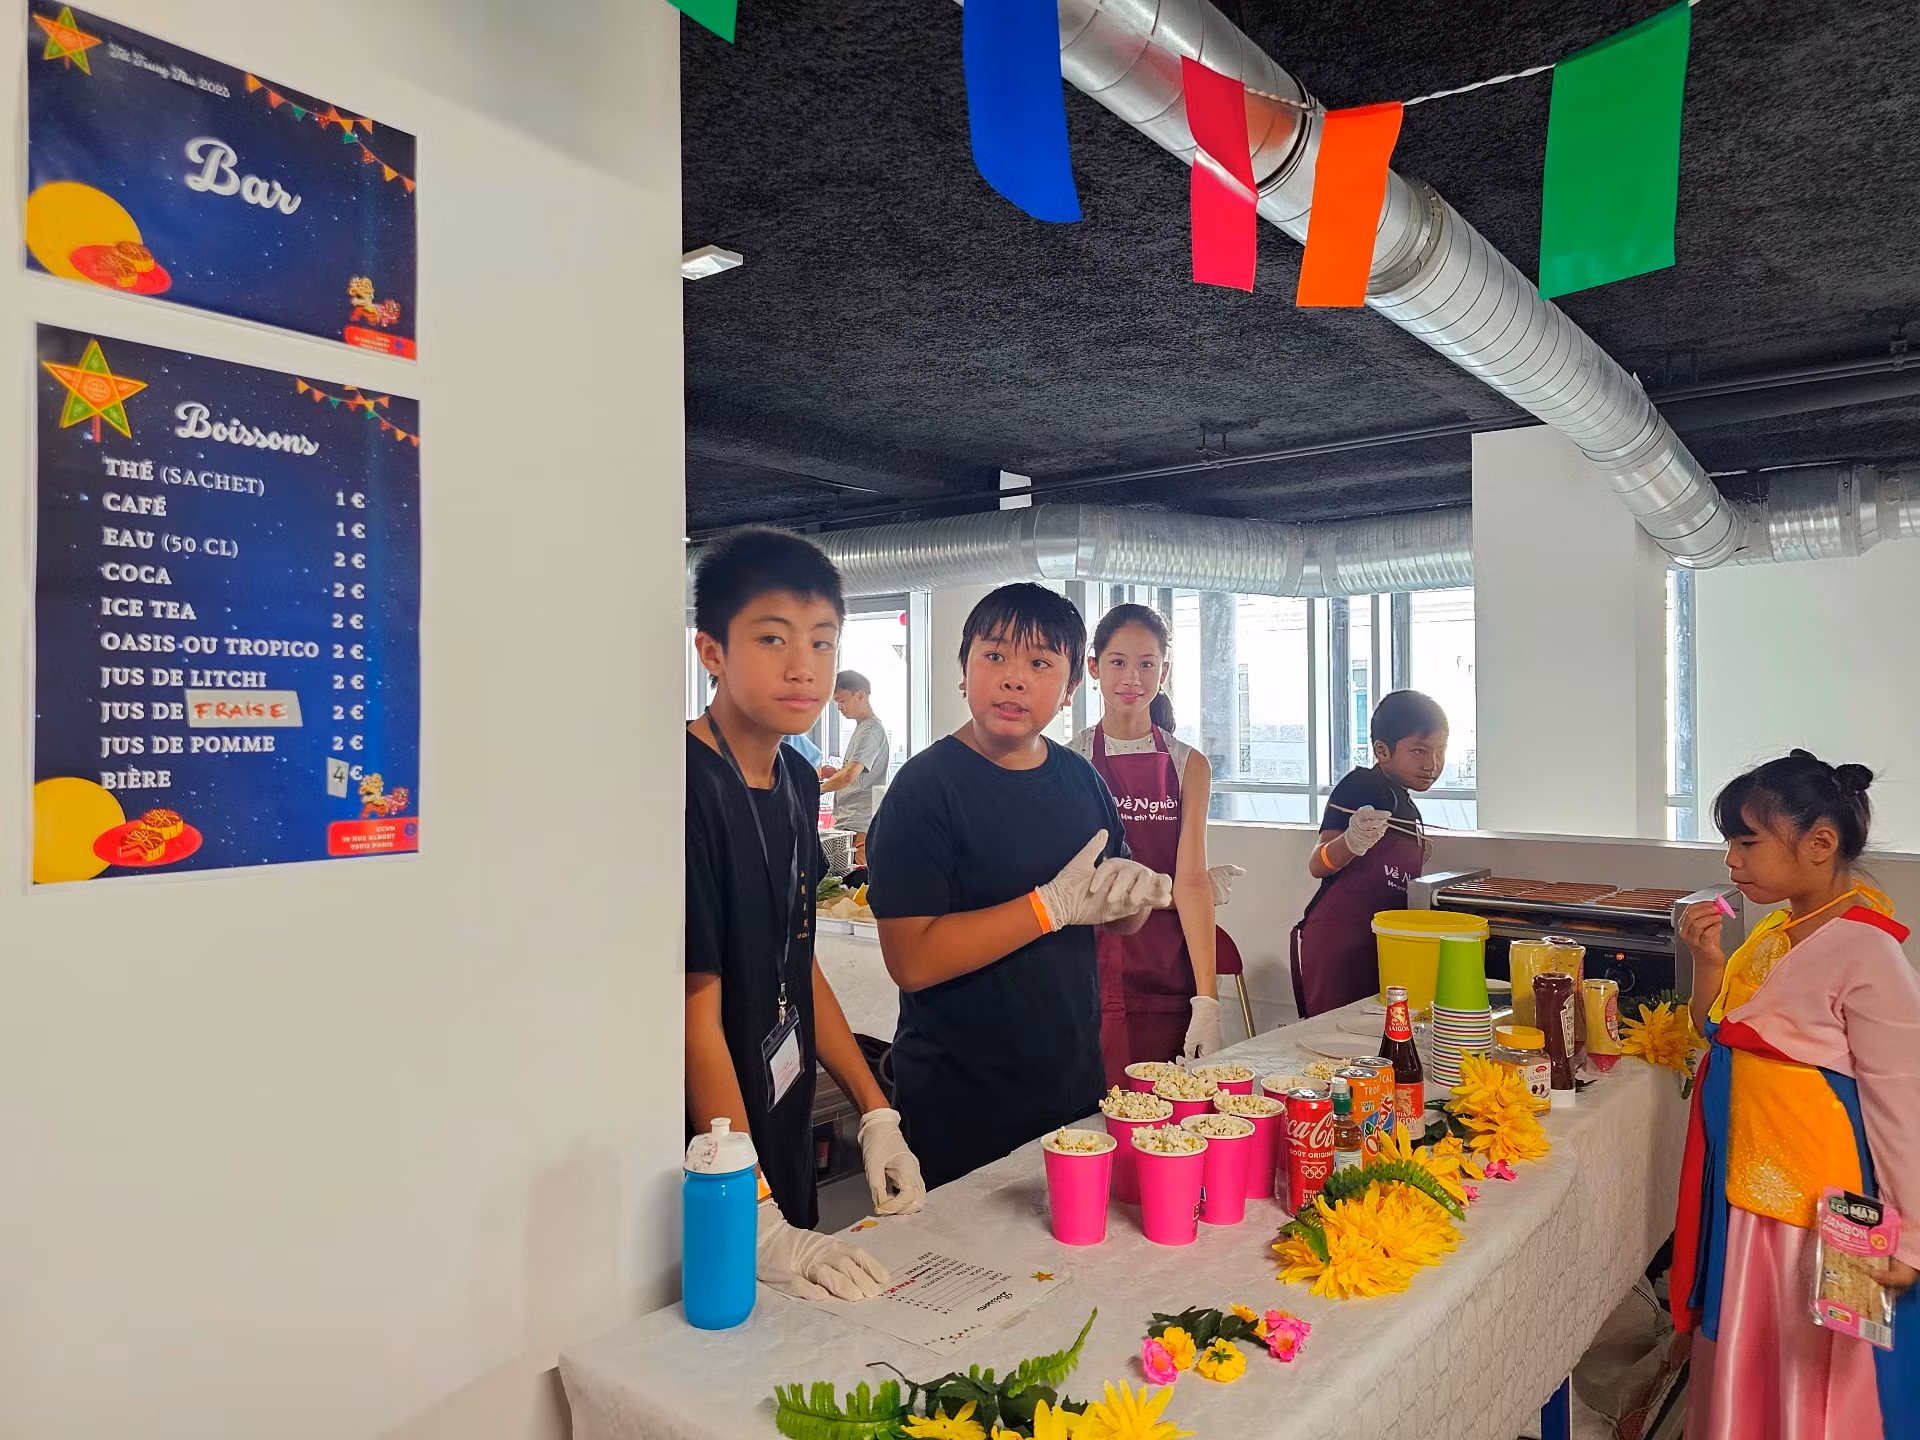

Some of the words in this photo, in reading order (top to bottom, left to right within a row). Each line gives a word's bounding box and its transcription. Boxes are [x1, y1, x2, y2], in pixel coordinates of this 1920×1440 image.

[199, 77, 231, 98] 2023
[184, 136, 302, 215] Bar
[174, 400, 320, 457] Boissons
[102, 455, 154, 482] THÉ
[160, 465, 265, 497] (SACHET)
[102, 492, 167, 517] CAFÉ
[335, 491, 345, 508] 1
[351, 493, 366, 510] €
[335, 521, 345, 538] 1
[351, 523, 366, 540] €
[102, 526, 154, 550] EAU
[161, 533, 196, 554] (50
[203, 537, 239, 559] CL)
[333, 551, 346, 568] 2
[351, 553, 366, 570] €
[102, 562, 172, 586] COCA
[333, 582, 346, 598] 2
[351, 584, 366, 600] €
[101, 597, 144, 618] ICE
[151, 599, 197, 620] TEA
[332, 613, 346, 629] 2
[350, 614, 365, 630] €
[101, 631, 176, 654] OASIS
[183, 636, 218, 655] OU
[224, 637, 320, 658] TROPICO
[332, 643, 346, 660] 2
[350, 644, 365, 661] €
[101, 666, 145, 688] JUS
[151, 668, 184, 687] DE
[190, 668, 268, 688] LITCHI
[332, 674, 346, 690] 2
[350, 675, 365, 691] €
[101, 701, 145, 721] JUS
[151, 702, 184, 720] DE
[332, 704, 346, 720] 2
[350, 704, 365, 720] €
[101, 735, 145, 758] JUS
[151, 736, 184, 754] DE
[190, 735, 276, 754] POMME
[332, 735, 346, 751] 2
[350, 735, 365, 751] €
[102, 768, 172, 790] BIÈRE
[333, 766, 345, 784] 4
[350, 765, 364, 781] €
[1823, 1215, 1867, 1239] JAMBON
